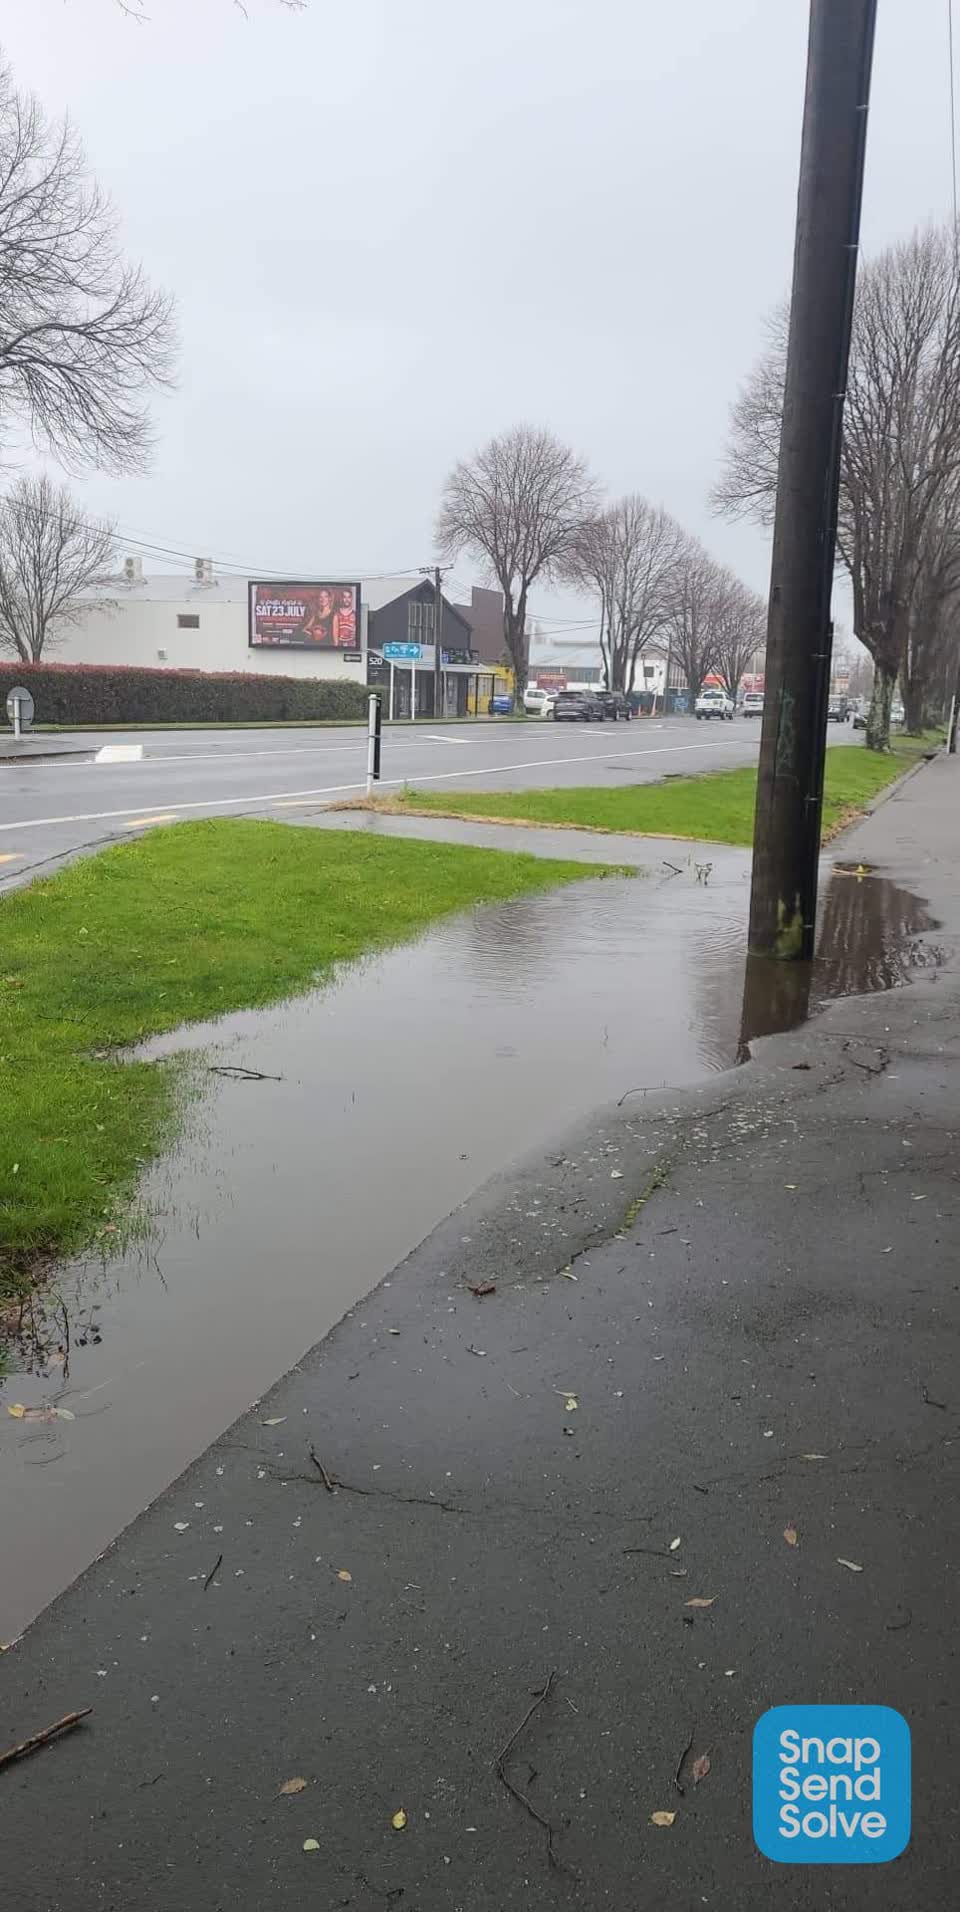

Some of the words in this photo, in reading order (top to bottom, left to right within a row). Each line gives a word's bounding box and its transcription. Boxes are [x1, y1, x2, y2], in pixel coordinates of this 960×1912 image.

[256, 605, 272, 616] SAT
[272, 606, 284, 616] 23
[285, 606, 305, 617] JULY
